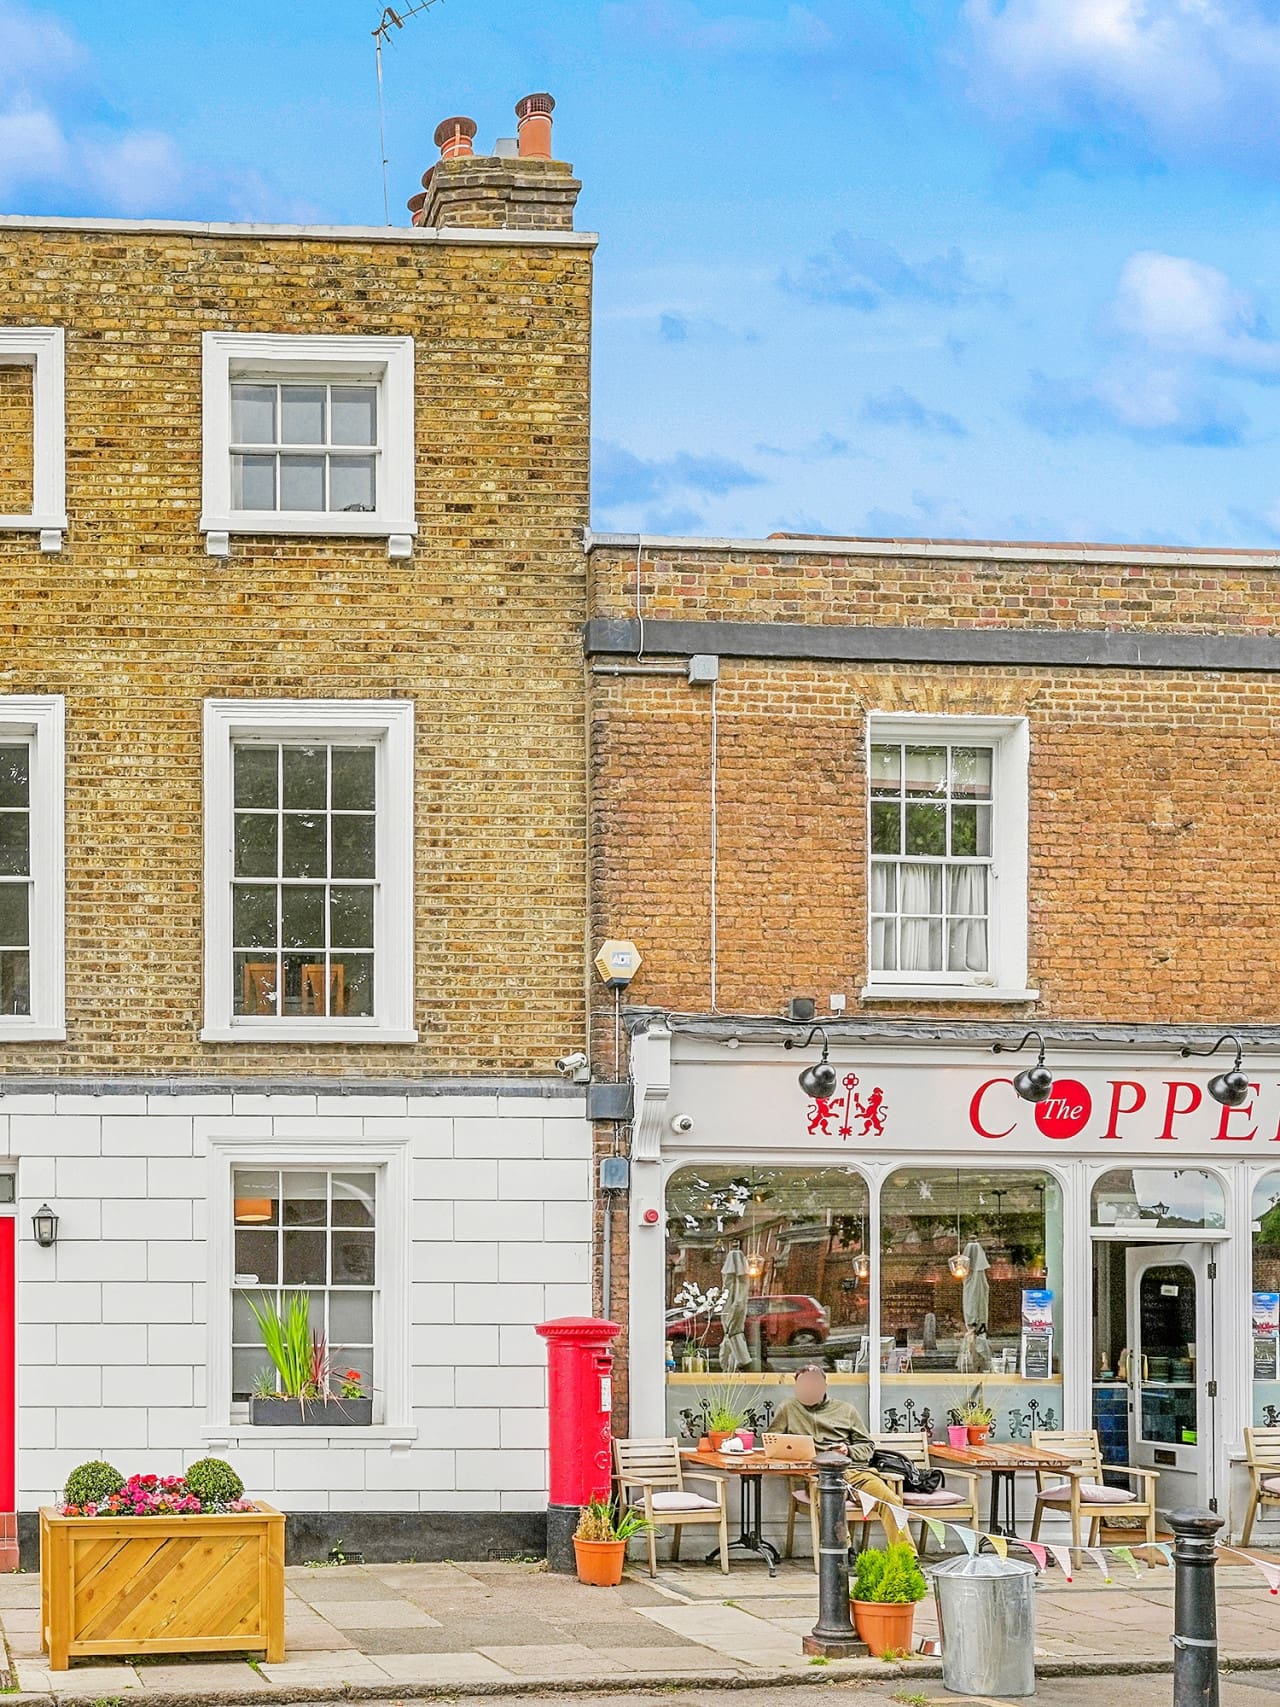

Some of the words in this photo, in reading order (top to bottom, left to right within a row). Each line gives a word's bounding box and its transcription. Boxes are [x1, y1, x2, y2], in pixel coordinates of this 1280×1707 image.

[612, 954, 632, 965] ADT
[969, 1077, 1280, 1142] COPPE
[1042, 1097, 1084, 1121] The
